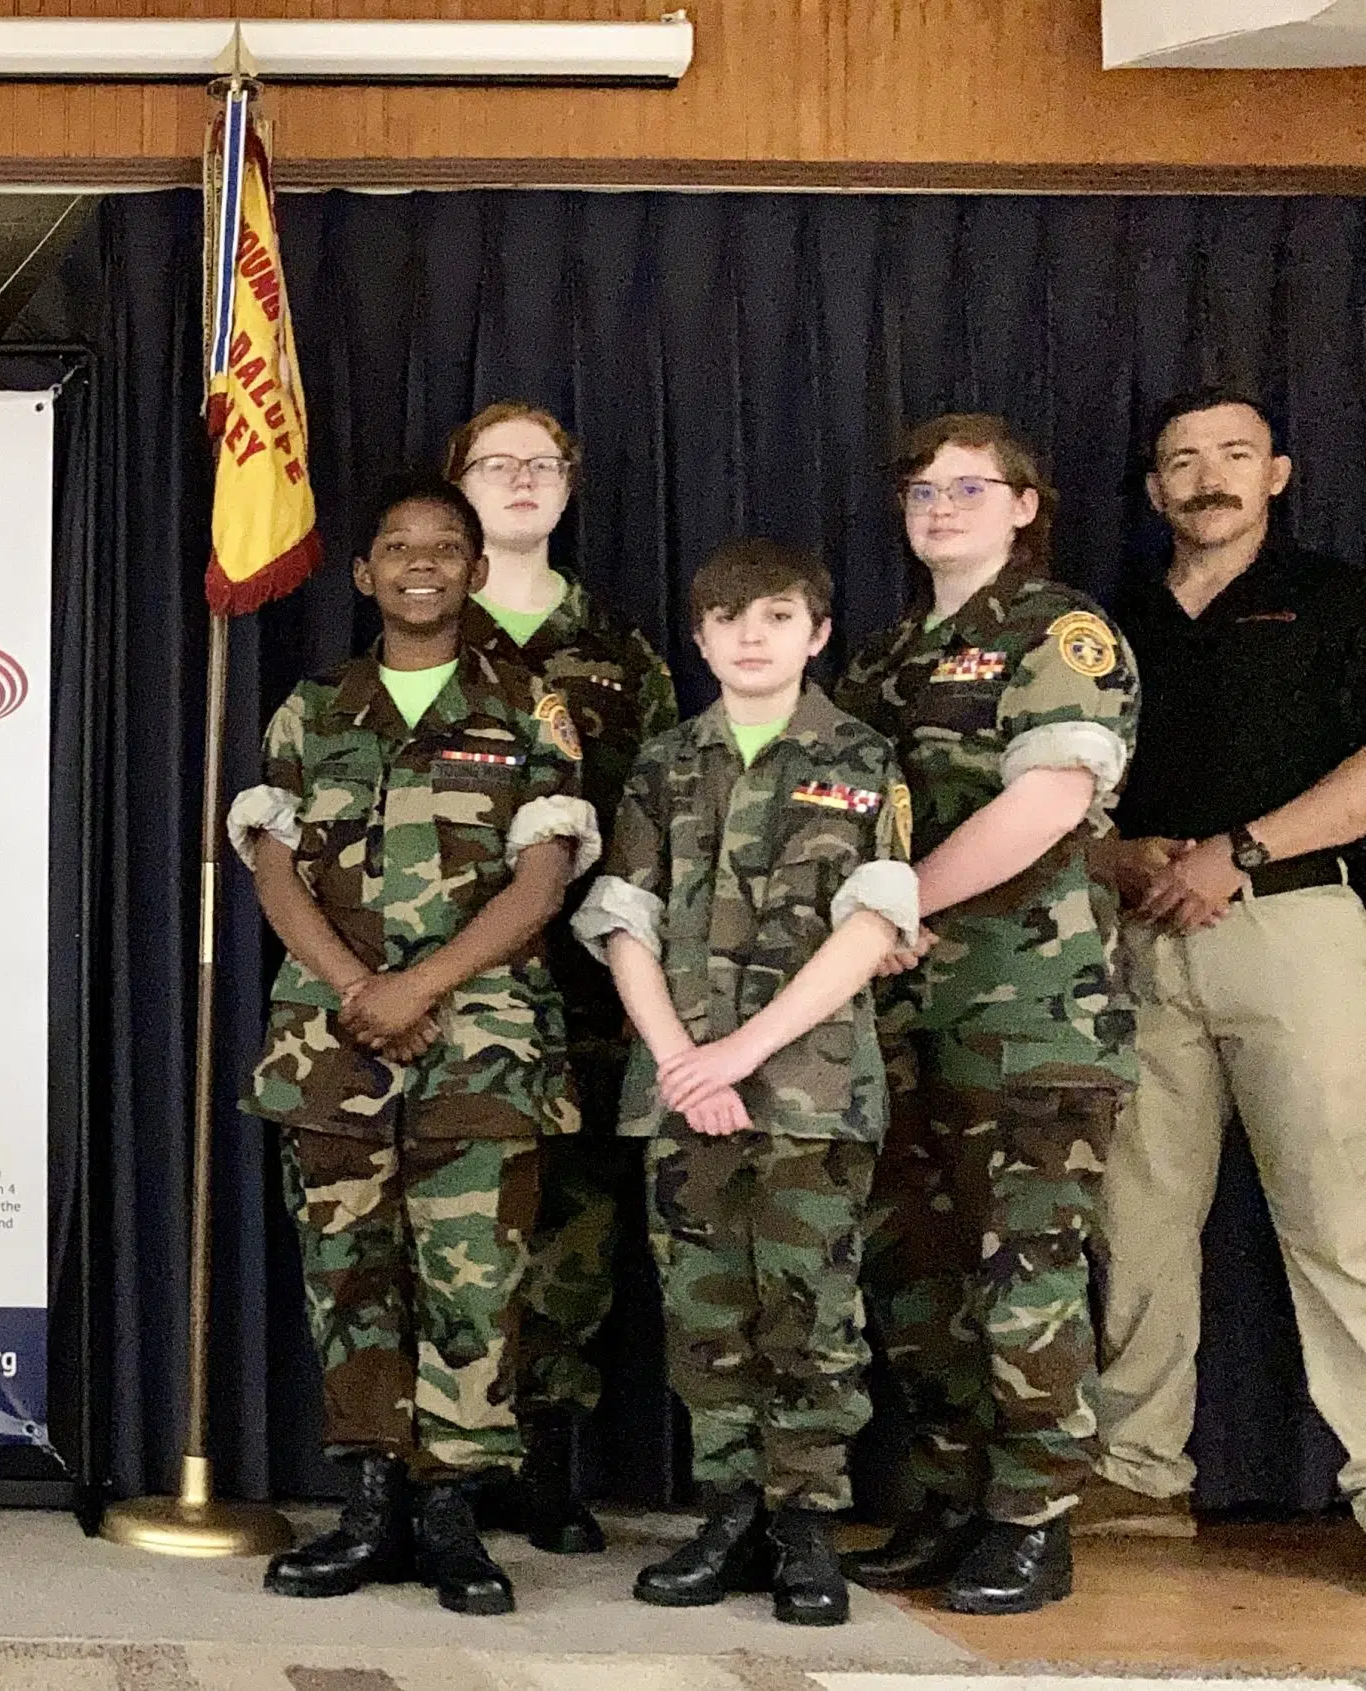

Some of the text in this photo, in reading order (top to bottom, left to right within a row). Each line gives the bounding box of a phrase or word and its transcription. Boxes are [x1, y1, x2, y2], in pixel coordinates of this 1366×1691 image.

[238, 222, 280, 321] OUNG
[8, 1184, 15, 1194] 4
[0, 1201, 21, 1212] the
